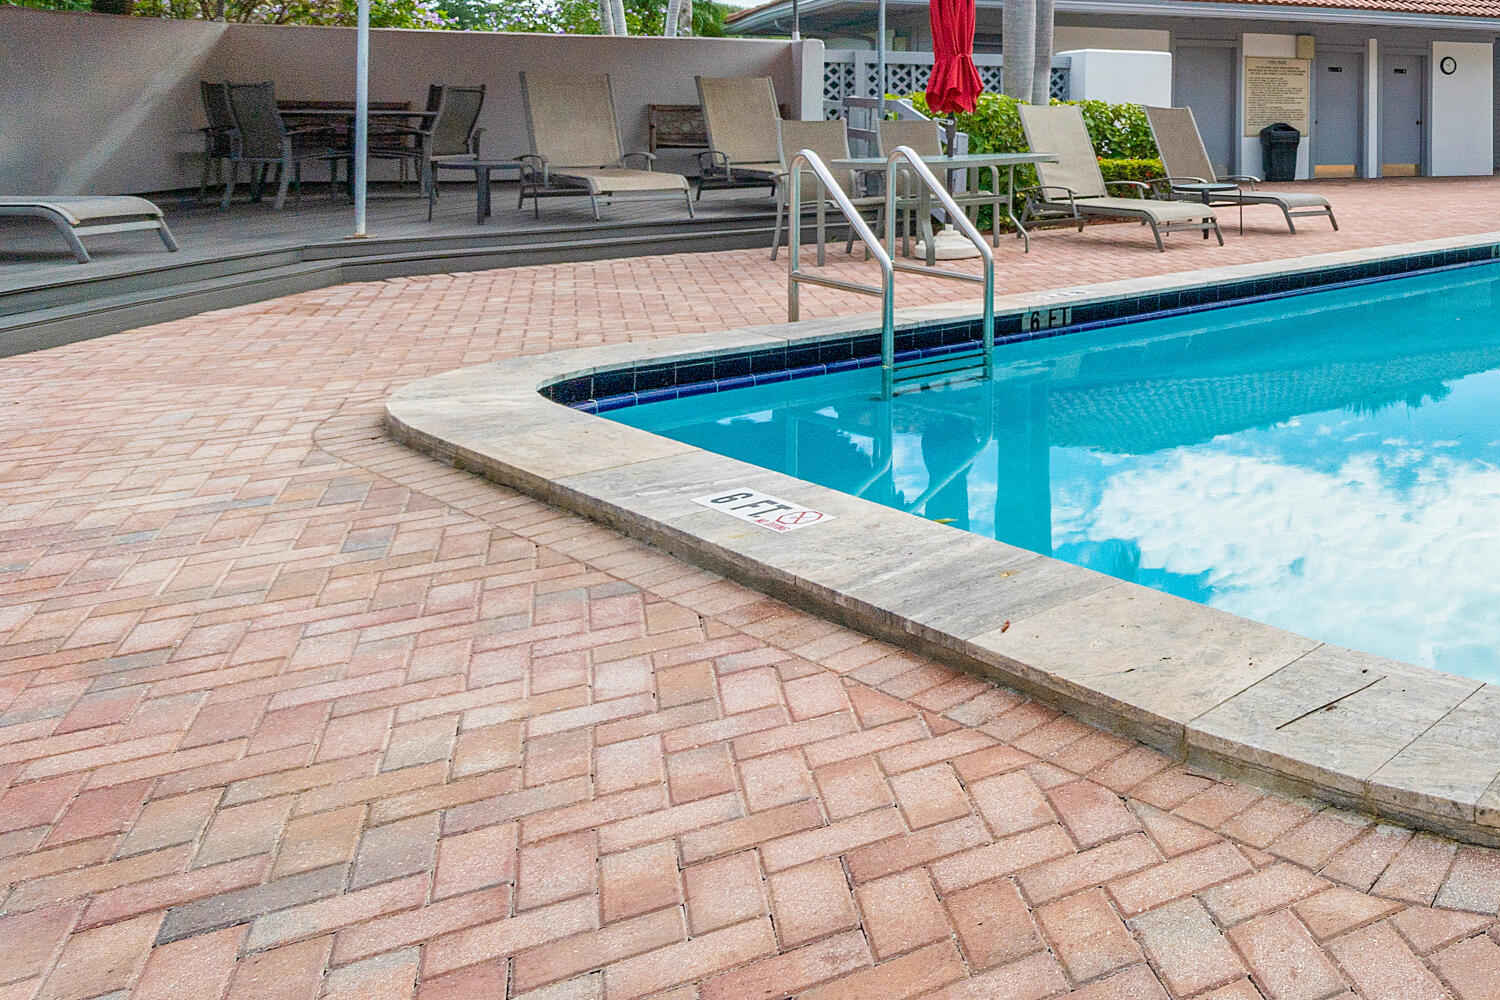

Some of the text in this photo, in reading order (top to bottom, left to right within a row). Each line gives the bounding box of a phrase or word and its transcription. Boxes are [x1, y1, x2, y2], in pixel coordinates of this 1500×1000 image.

[1030, 306, 1071, 331] 6 FT
[710, 492, 754, 504] 6
